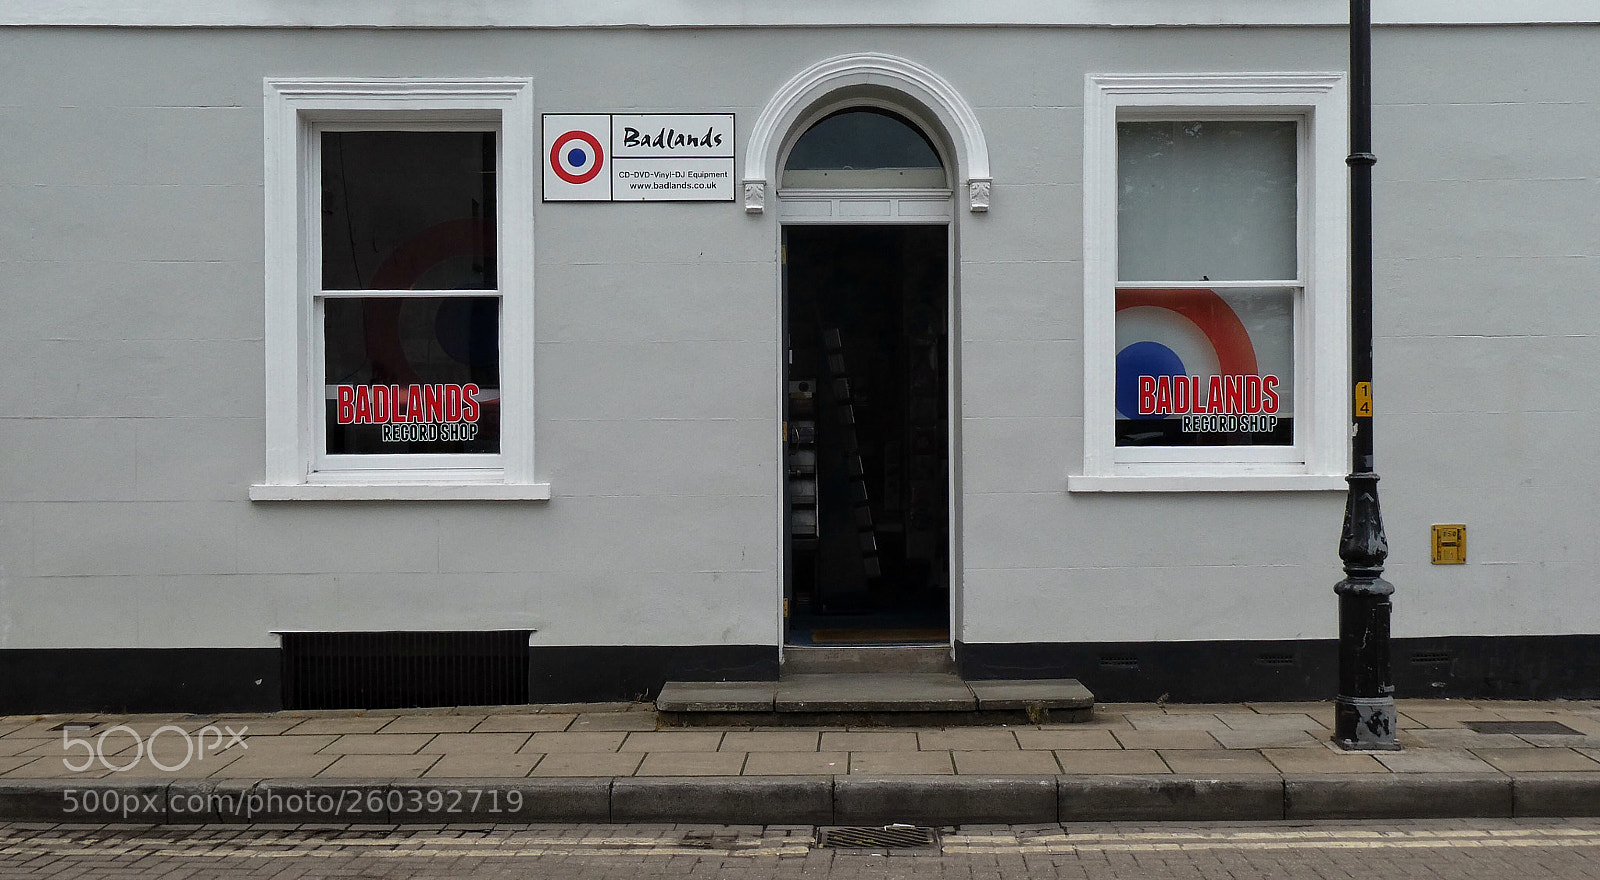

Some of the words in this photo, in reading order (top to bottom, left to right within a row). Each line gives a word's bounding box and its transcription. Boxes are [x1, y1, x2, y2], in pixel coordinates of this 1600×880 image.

[624, 127, 722, 149] Badlands
[618, 171, 686, 179] CD-DVD-Vinyl-DJ
[687, 171, 728, 179] Equipment
[629, 181, 717, 190] www.badlands.co.uk
[1138, 375, 1280, 415] BADLANDS
[1361, 384, 1368, 397] 1
[337, 384, 480, 424] BADLANDS
[1359, 401, 1370, 414] 4
[382, 424, 438, 442] RECORD
[440, 423, 479, 442] SHOP
[1182, 415, 1239, 433] RECORD
[1240, 415, 1278, 433] SHOP
